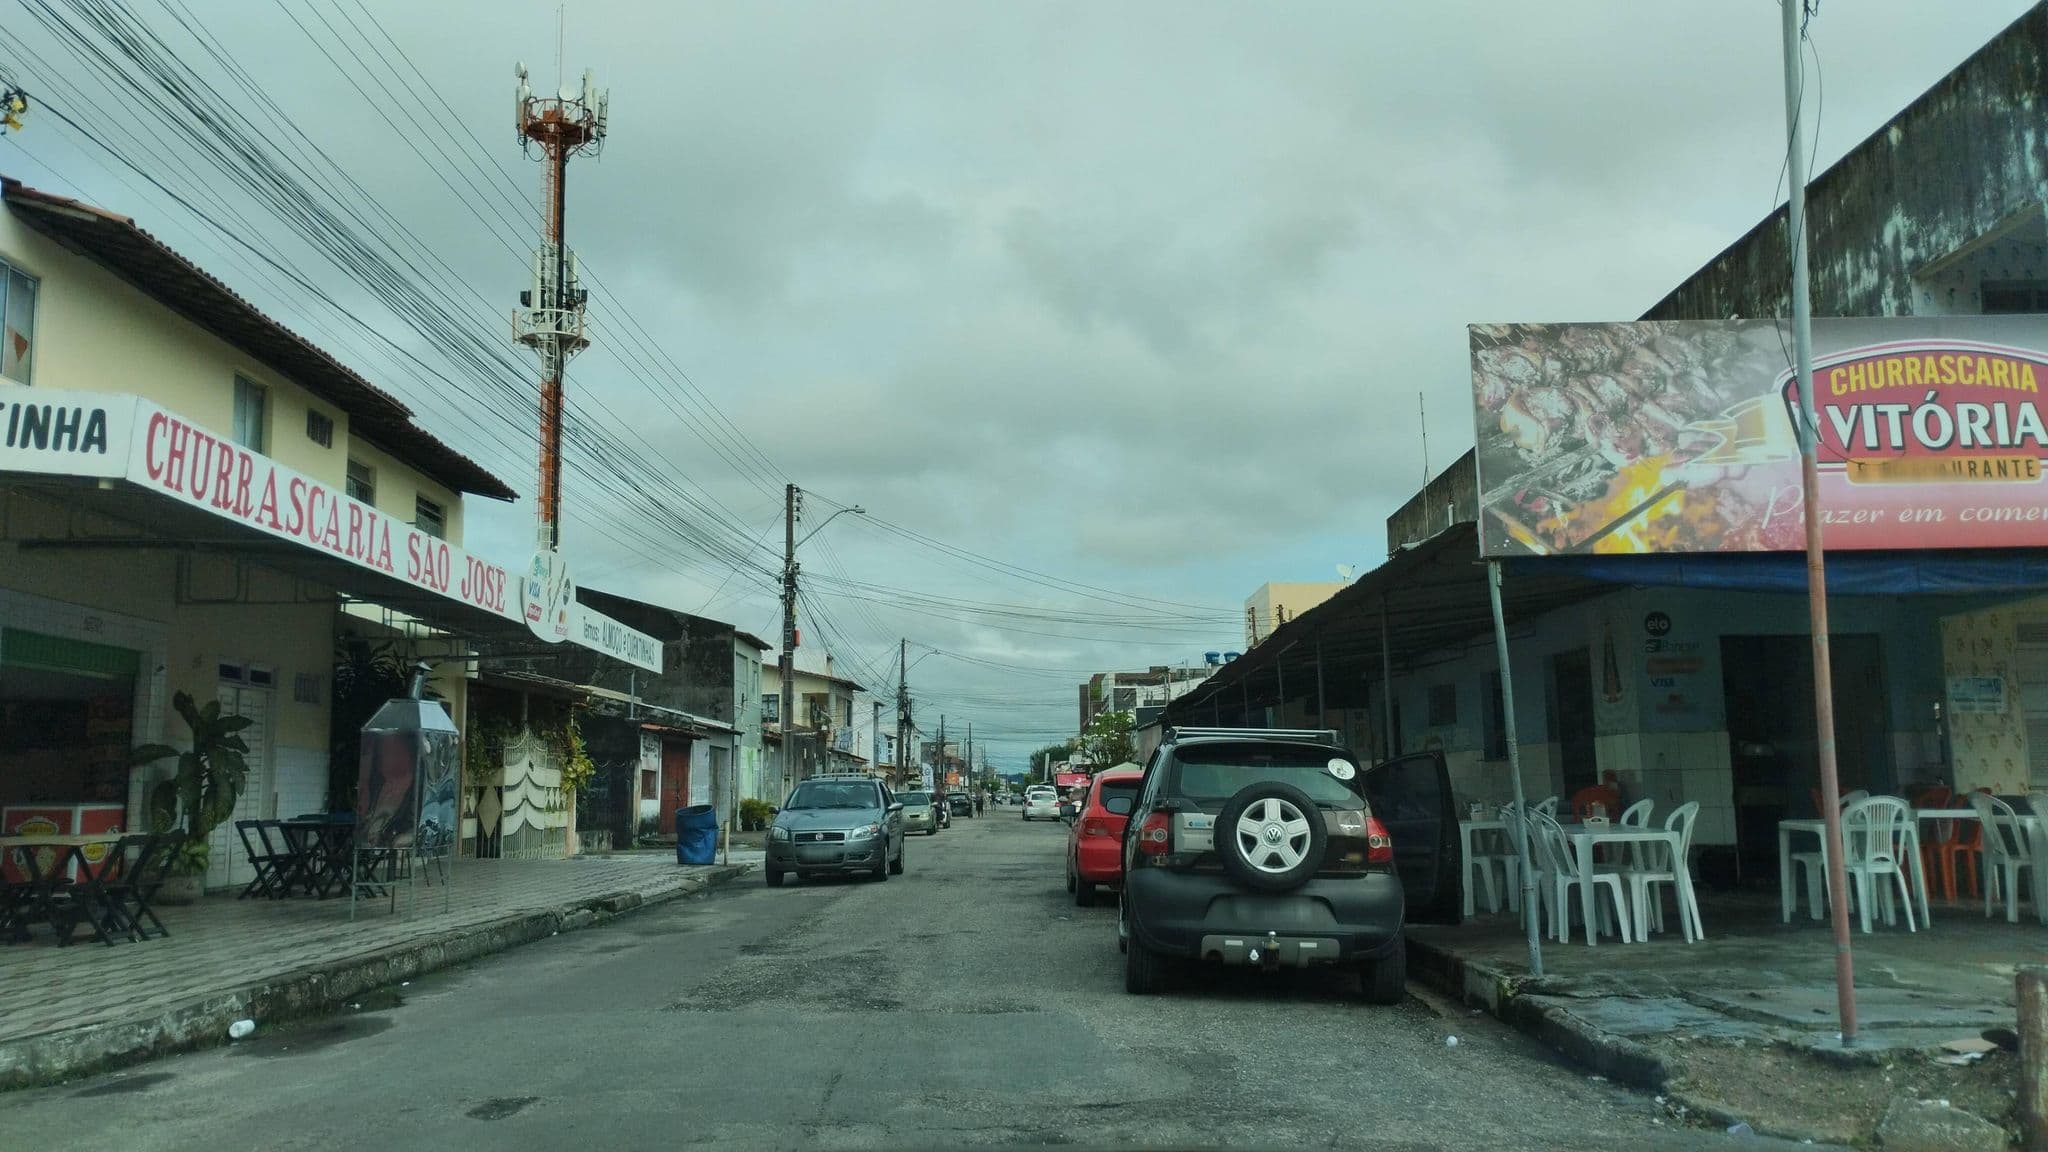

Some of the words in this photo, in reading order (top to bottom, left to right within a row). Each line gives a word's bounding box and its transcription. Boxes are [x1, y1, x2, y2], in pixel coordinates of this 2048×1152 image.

[1829, 354, 2039, 397] CHURRASCARIA
[0, 402, 107, 455] INHA
[1824, 389, 2048, 450] VITÓRIA
[1880, 458, 2036, 479] AURANTE
[145, 410, 394, 573] CHURRASCARIA
[460, 553, 507, 613] JOSÉ
[1899, 502, 1946, 524] em
